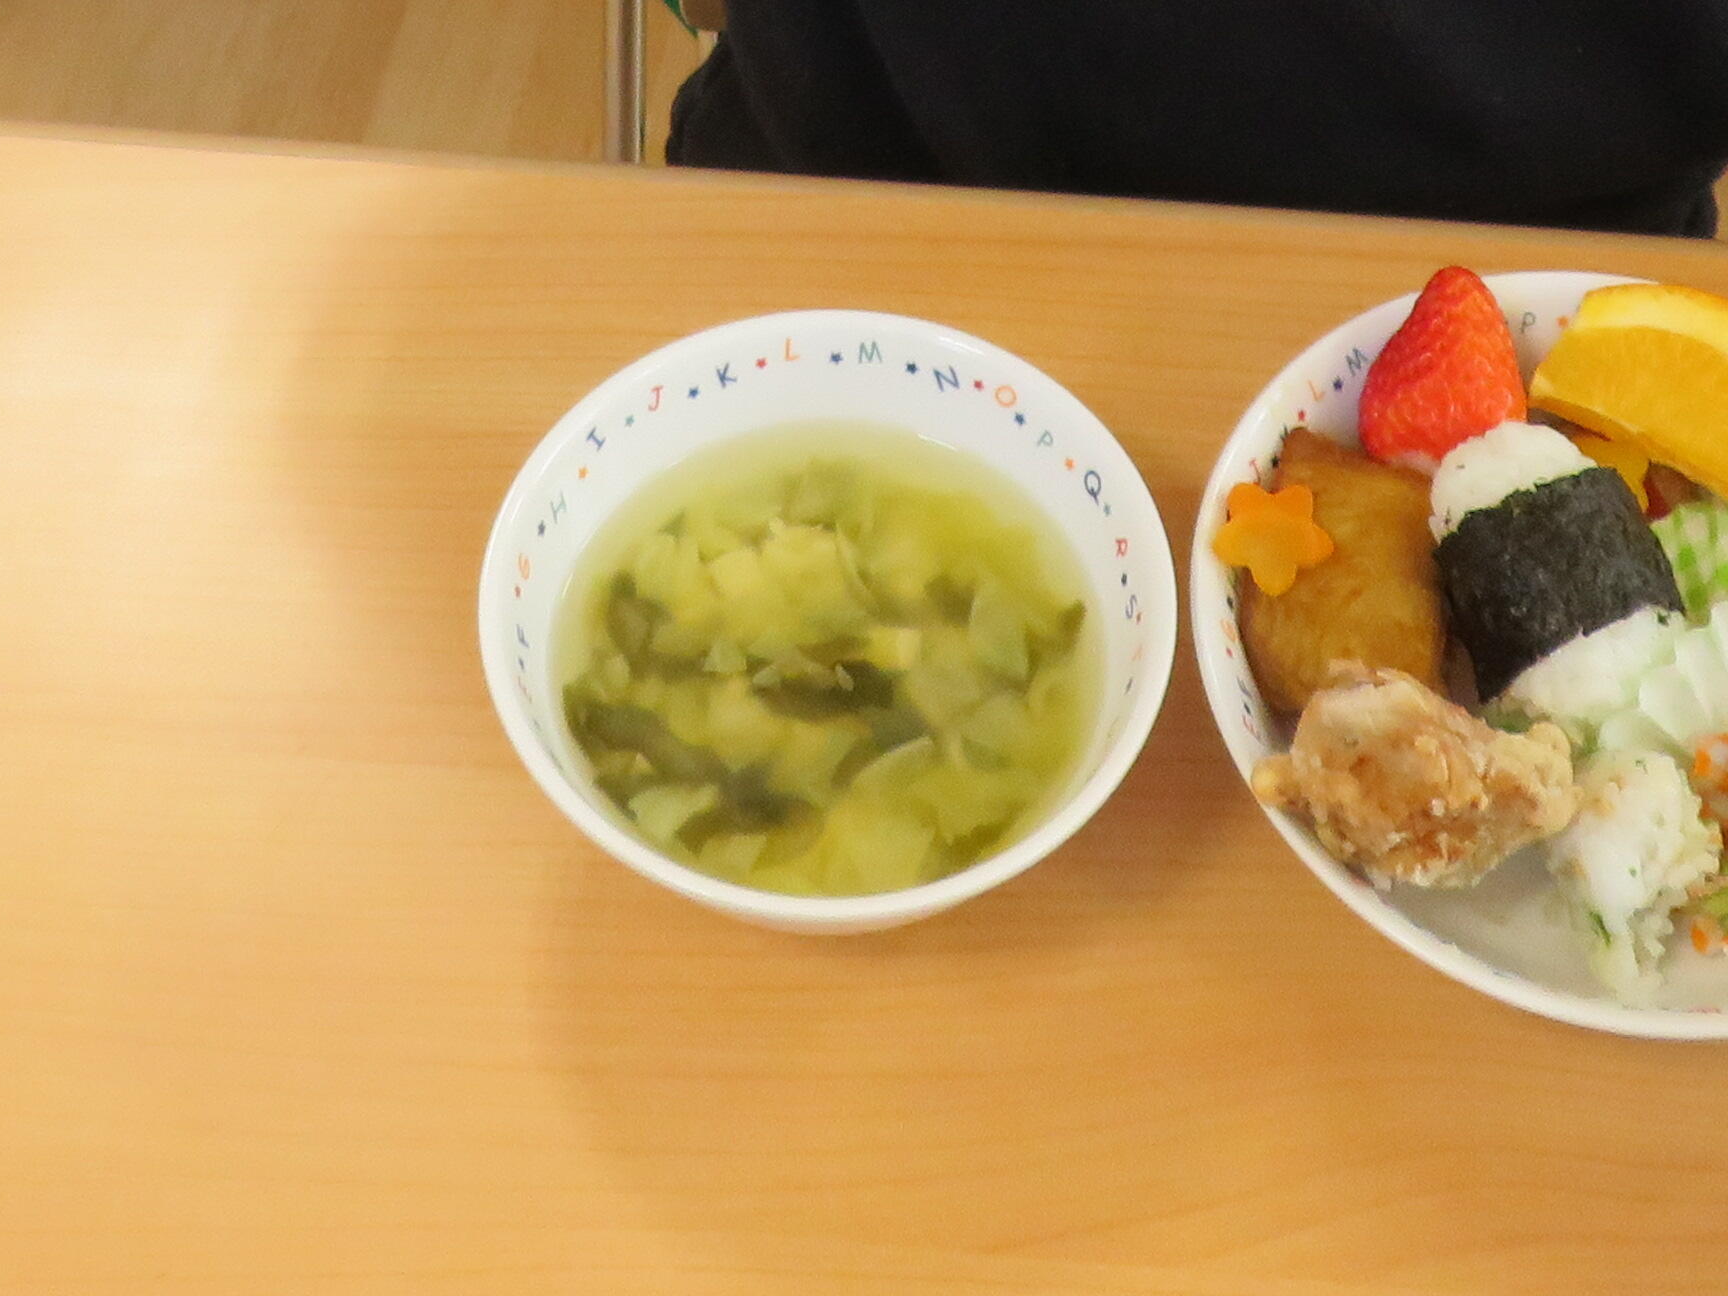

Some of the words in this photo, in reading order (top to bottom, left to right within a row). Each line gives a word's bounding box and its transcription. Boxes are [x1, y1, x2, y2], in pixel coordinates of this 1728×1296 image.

[647, 384, 664, 412] J
[715, 362, 738, 389] K
[784, 337, 801, 362] L
[857, 340, 883, 365] M
[933, 365, 961, 393] N
[994, 384, 1017, 407] O
[1036, 429, 1054, 448] P
[1083, 469, 1102, 506] Q
